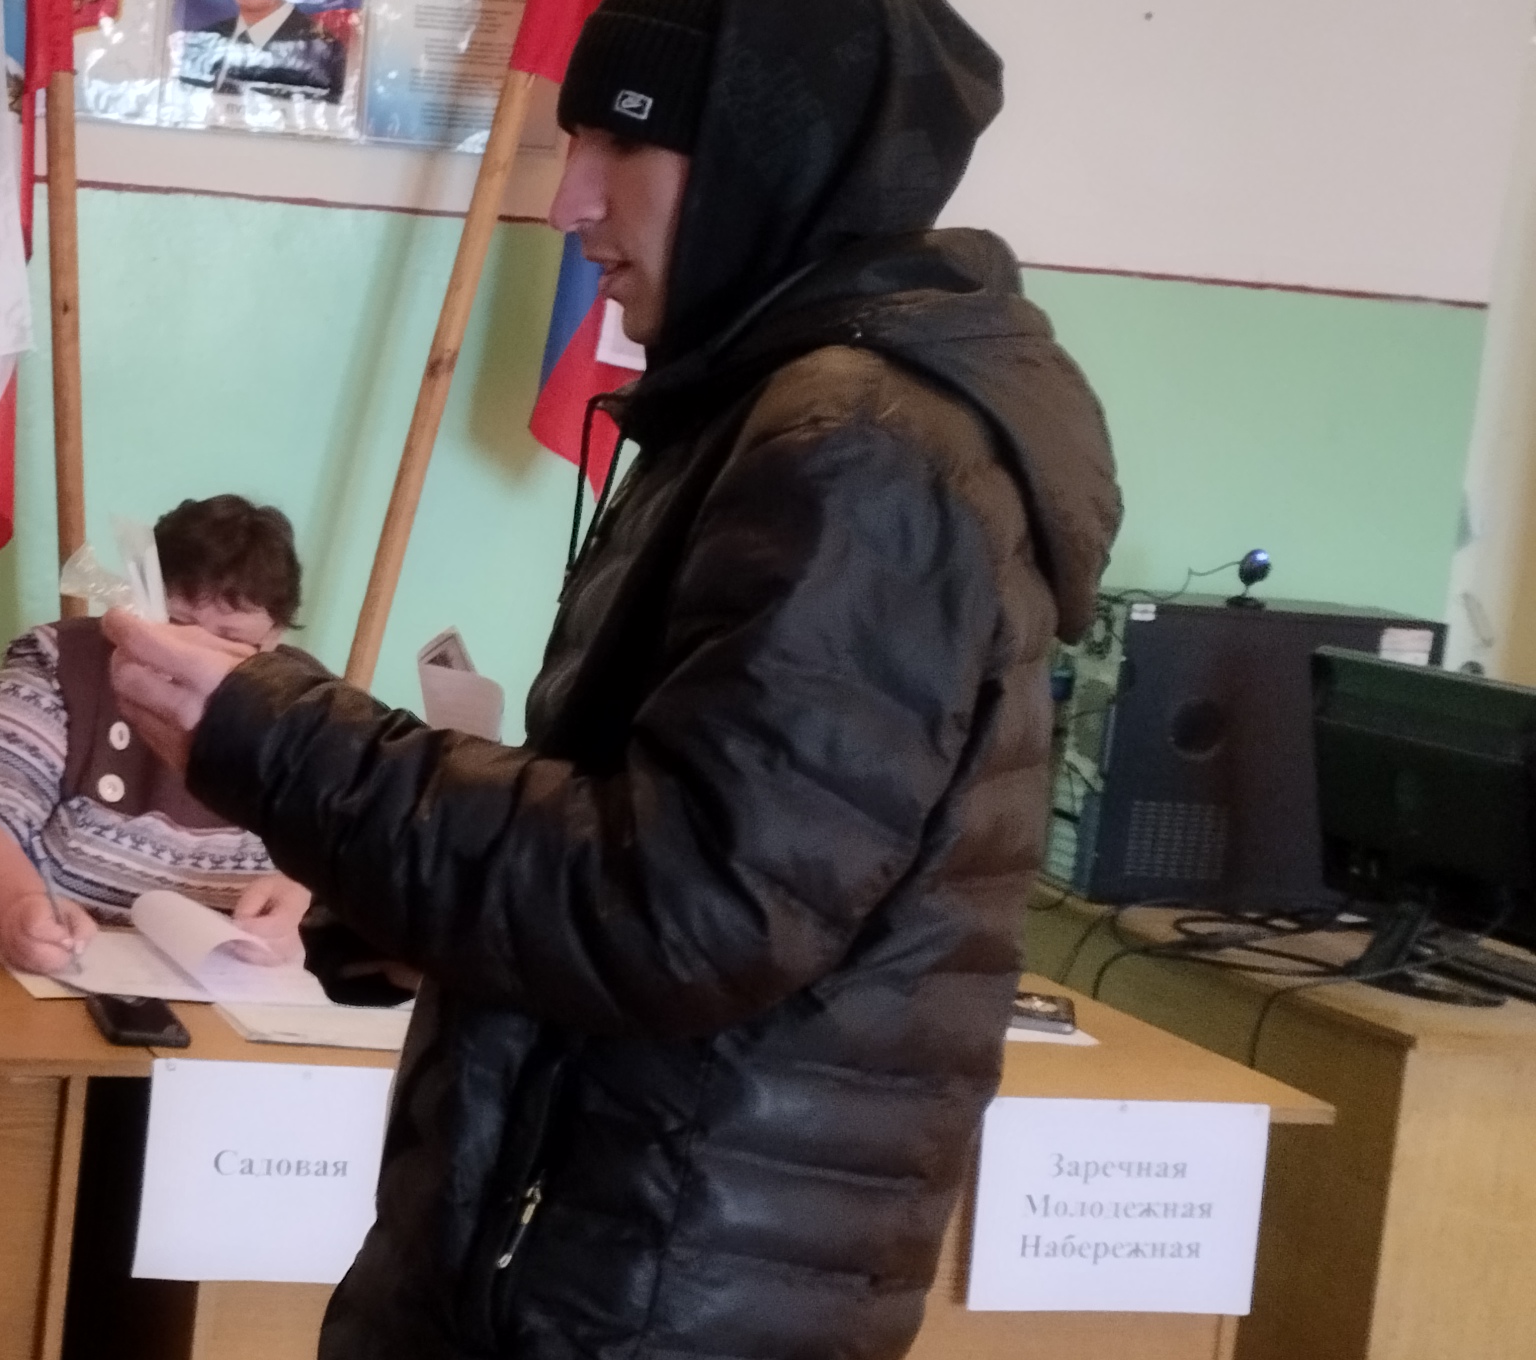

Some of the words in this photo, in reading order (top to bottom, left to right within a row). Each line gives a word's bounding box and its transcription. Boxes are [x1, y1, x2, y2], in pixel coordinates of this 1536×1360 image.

[213, 1149, 349, 1178] Садовая
[1050, 1153, 1187, 1183] Заречная
[1024, 1194, 1213, 1219] Молодежная
[1021, 1234, 1201, 1264] Набережная
